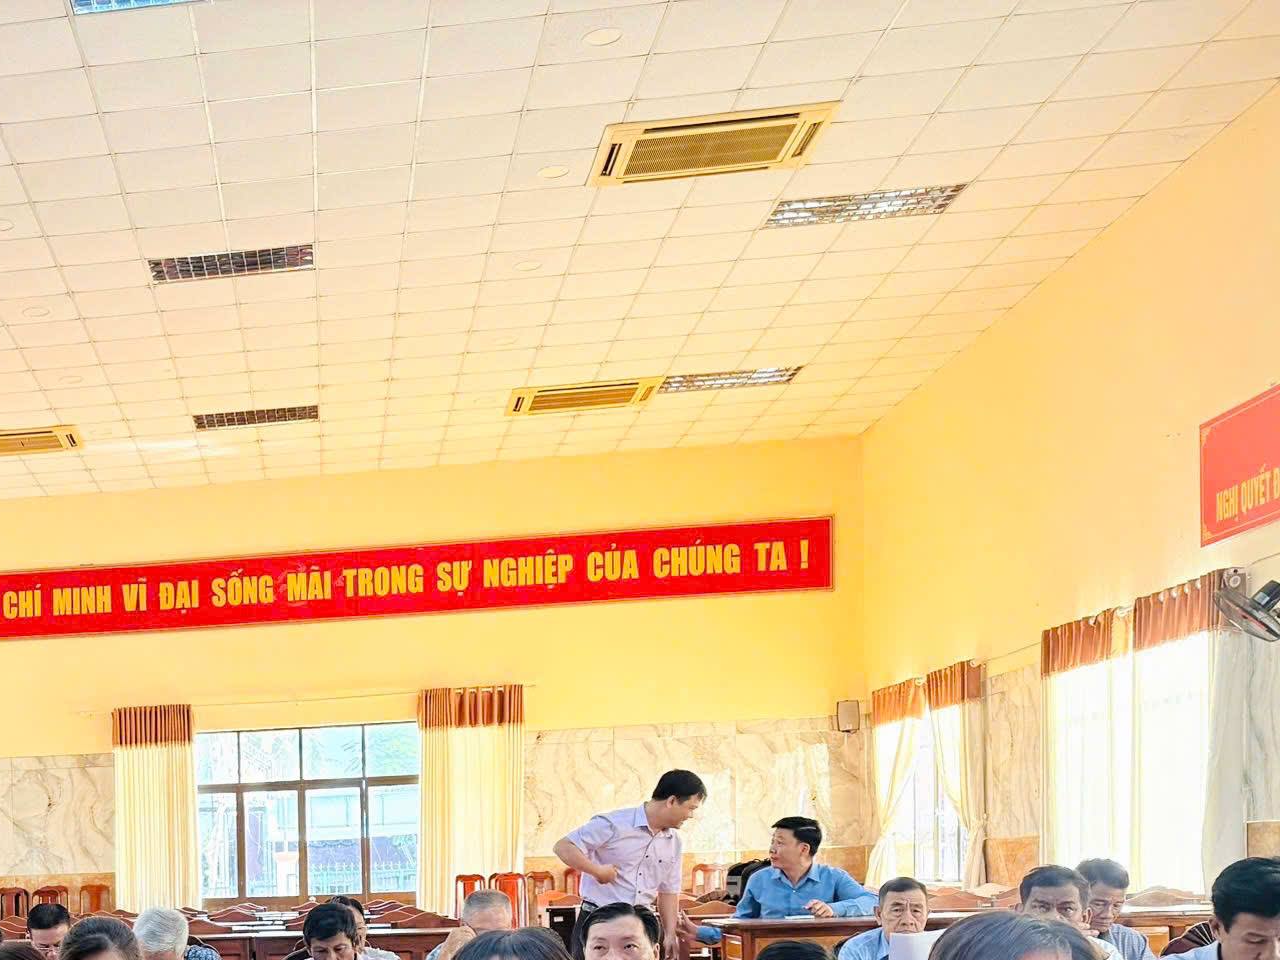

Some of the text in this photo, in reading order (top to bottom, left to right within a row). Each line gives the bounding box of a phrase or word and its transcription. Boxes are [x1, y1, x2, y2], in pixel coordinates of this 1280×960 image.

[1216, 483, 1238, 522] NGHỊ
[1241, 463, 1271, 514] QUYẾT
[2, 583, 42, 619] CHÍ
[52, 585, 112, 617] MINH
[122, 577, 148, 612] VĨ
[159, 579, 199, 615] ĐẠI
[211, 567, 274, 608] SỐNG
[286, 565, 331, 601] MÃI
[342, 565, 424, 598] TRONG
[436, 559, 472, 598] SỰ
[483, 548, 574, 590] NGHIỆP
[586, 542, 639, 583] CỦA
[652, 539, 741, 578] CHÚNG
[754, 540, 788, 572] TA
[800, 538, 810, 569] !
